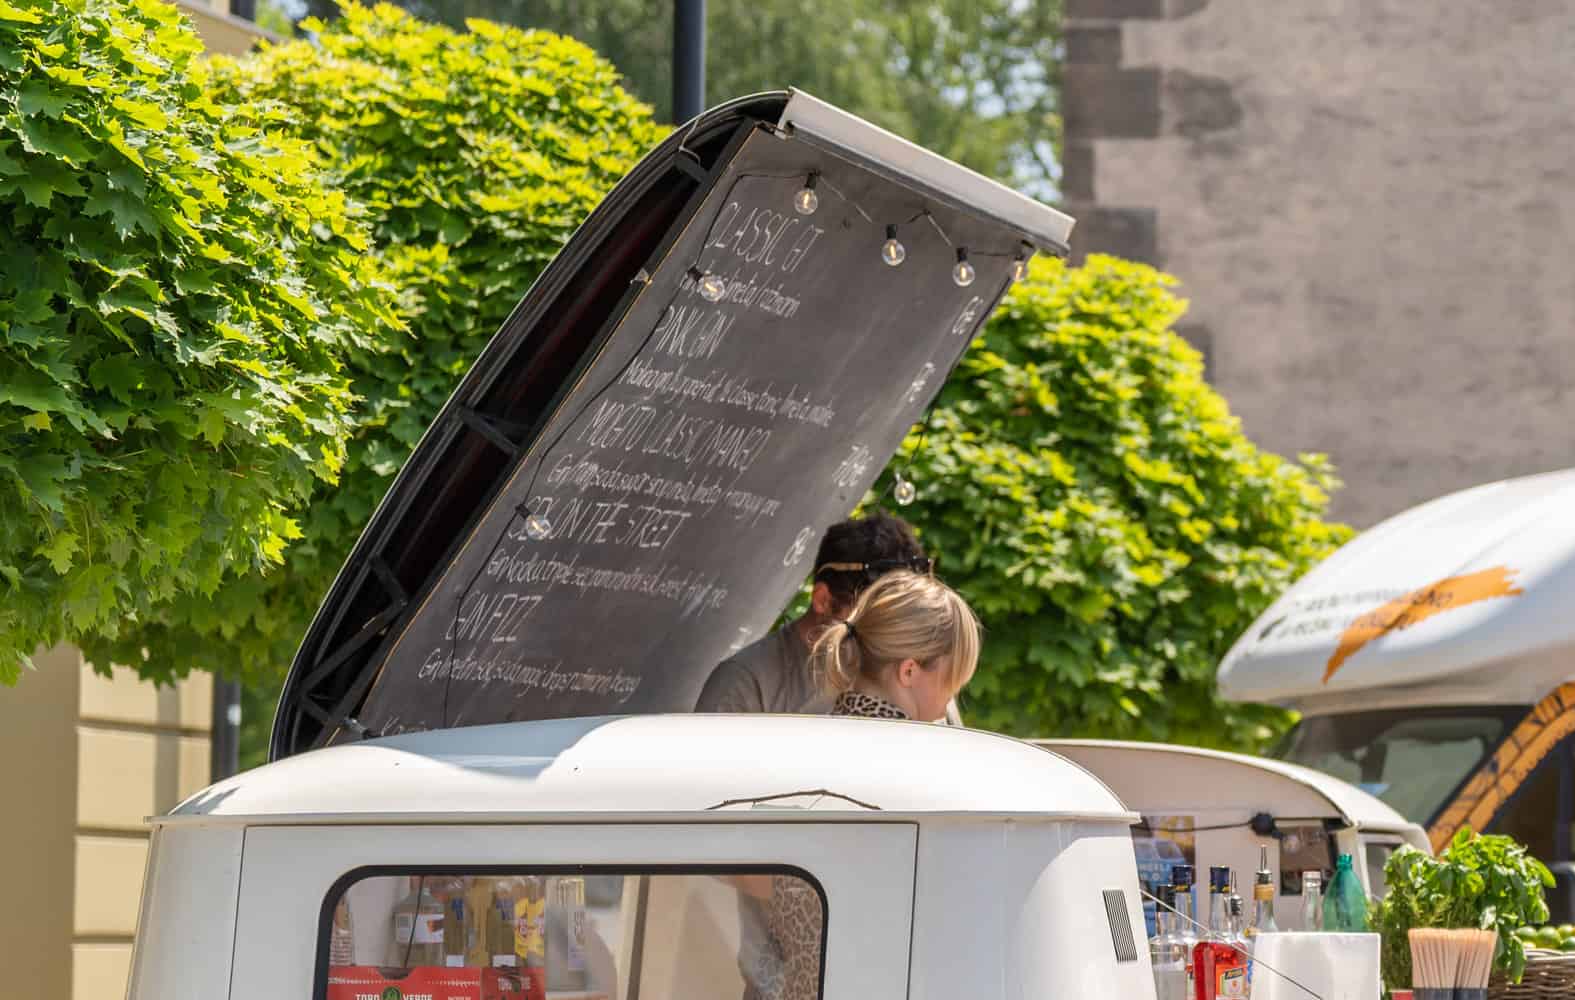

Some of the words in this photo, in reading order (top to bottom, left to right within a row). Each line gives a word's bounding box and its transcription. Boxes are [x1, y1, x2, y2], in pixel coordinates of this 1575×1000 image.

[704, 201, 799, 265] CLASSIC
[781, 224, 825, 273] GT
[615, 505, 693, 549] STREET
[478, 593, 543, 643] FIZZ
